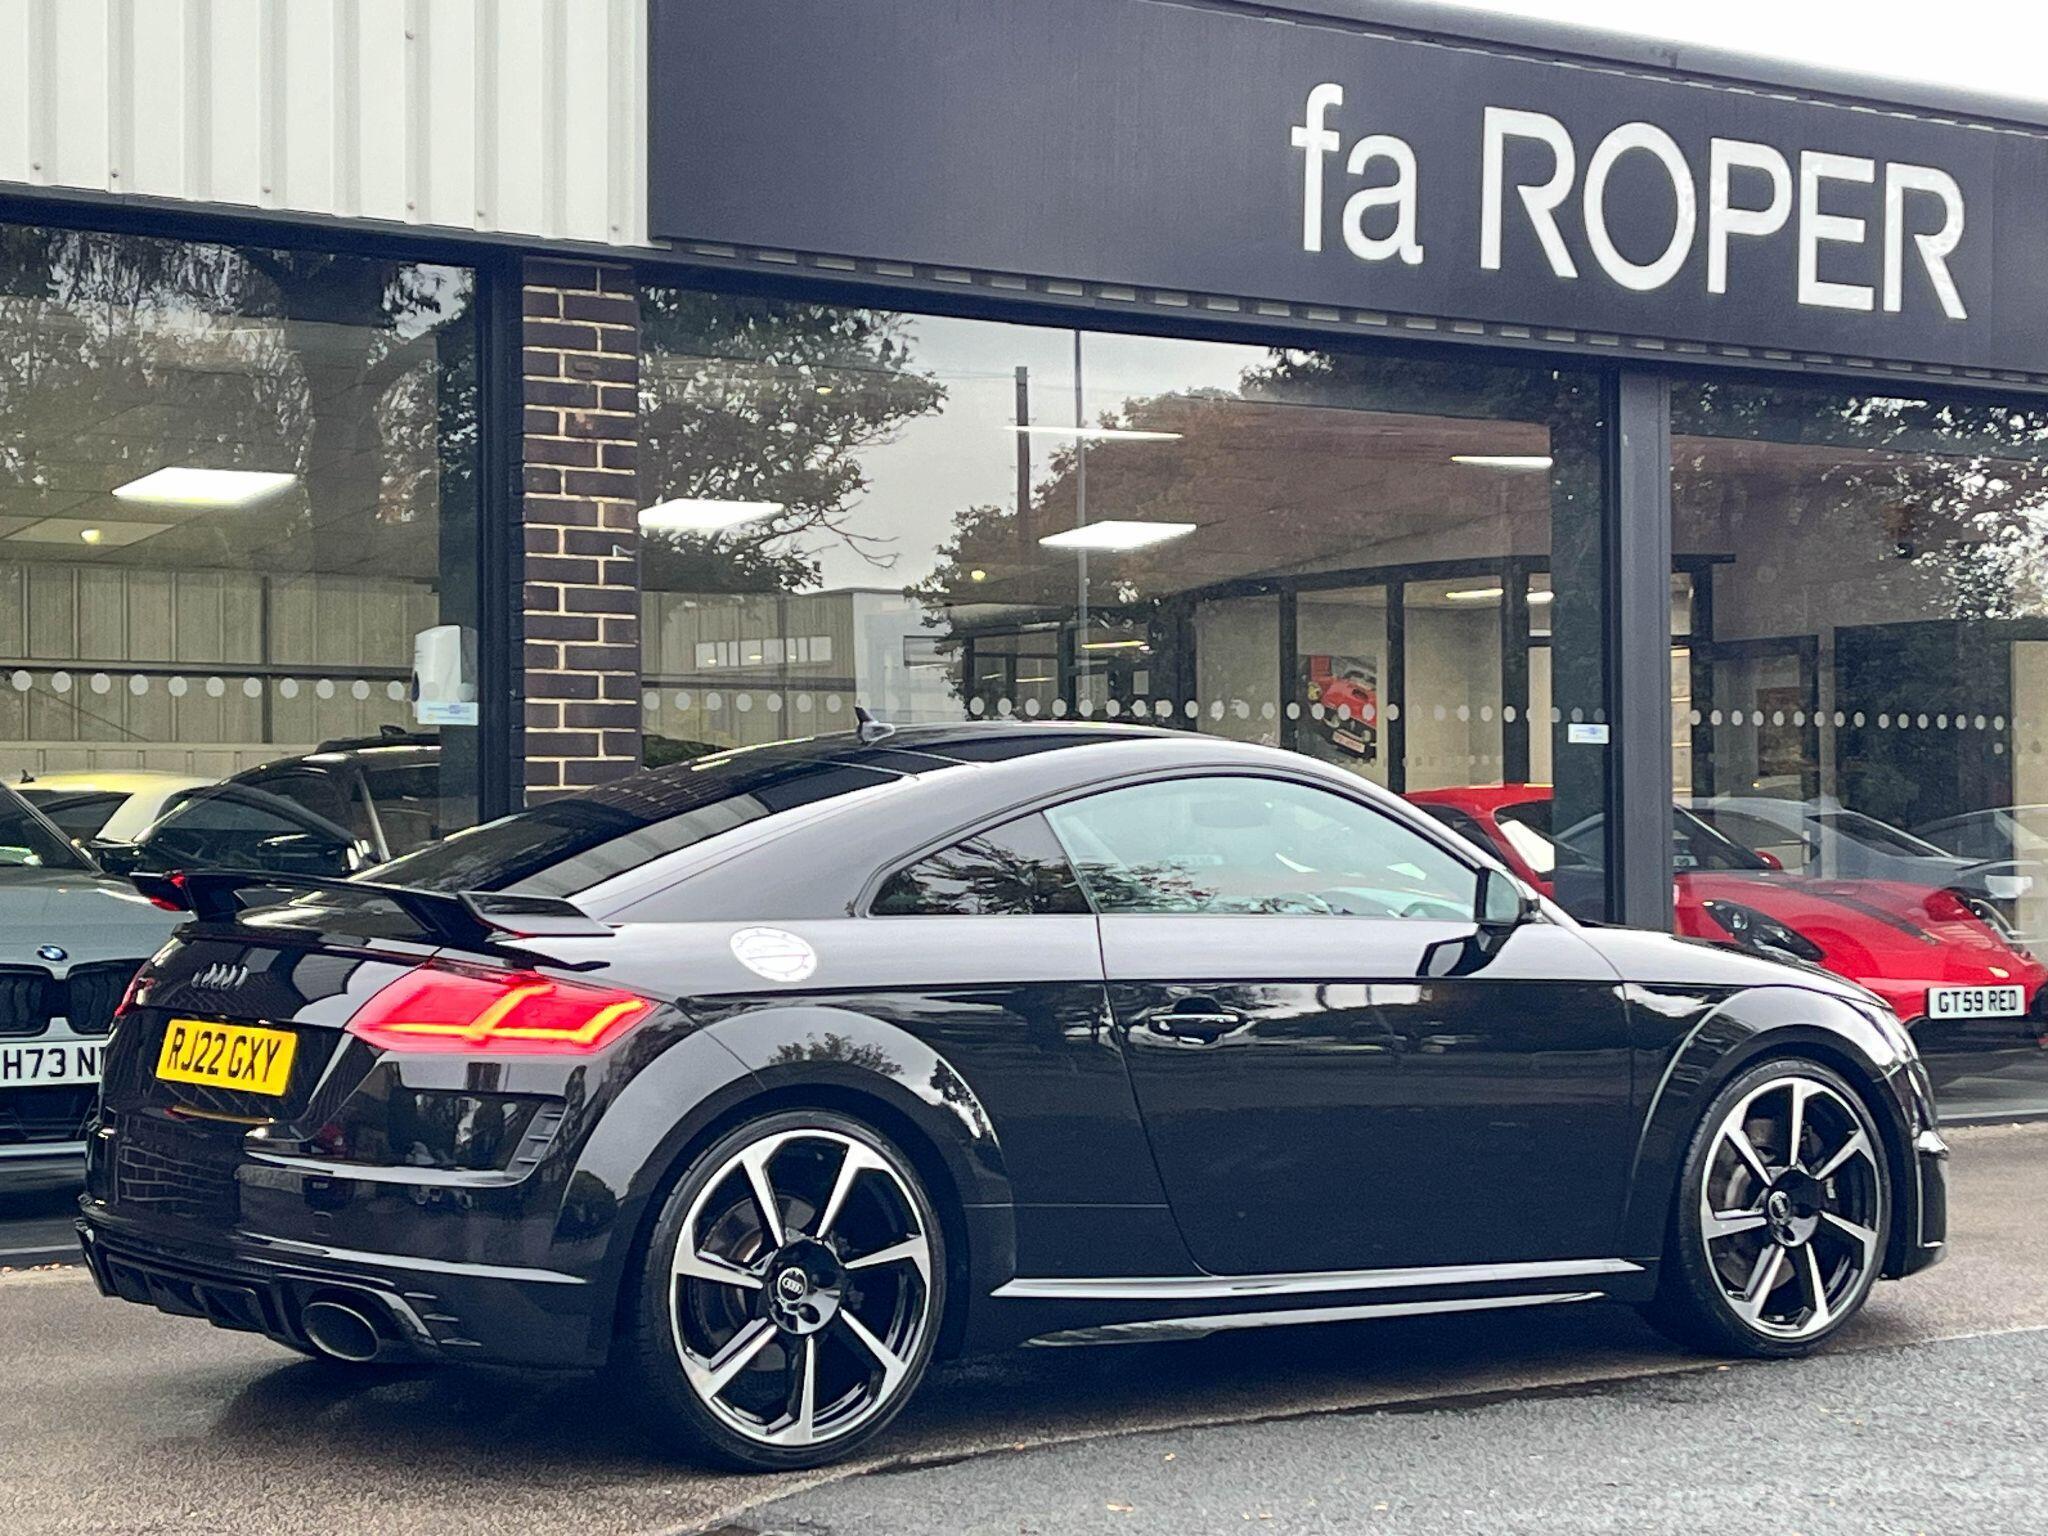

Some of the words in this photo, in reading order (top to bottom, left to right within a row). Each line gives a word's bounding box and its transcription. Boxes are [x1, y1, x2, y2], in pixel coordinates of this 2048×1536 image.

[1291, 83, 1423, 265] fa
[1480, 106, 1967, 320] ROPER
[1938, 990, 1984, 1013] GT59
[1988, 989, 2017, 1012] RED
[77, 1046, 106, 1077] N
[167, 1026, 227, 1076] RJ22
[228, 1034, 282, 1083] GXY
